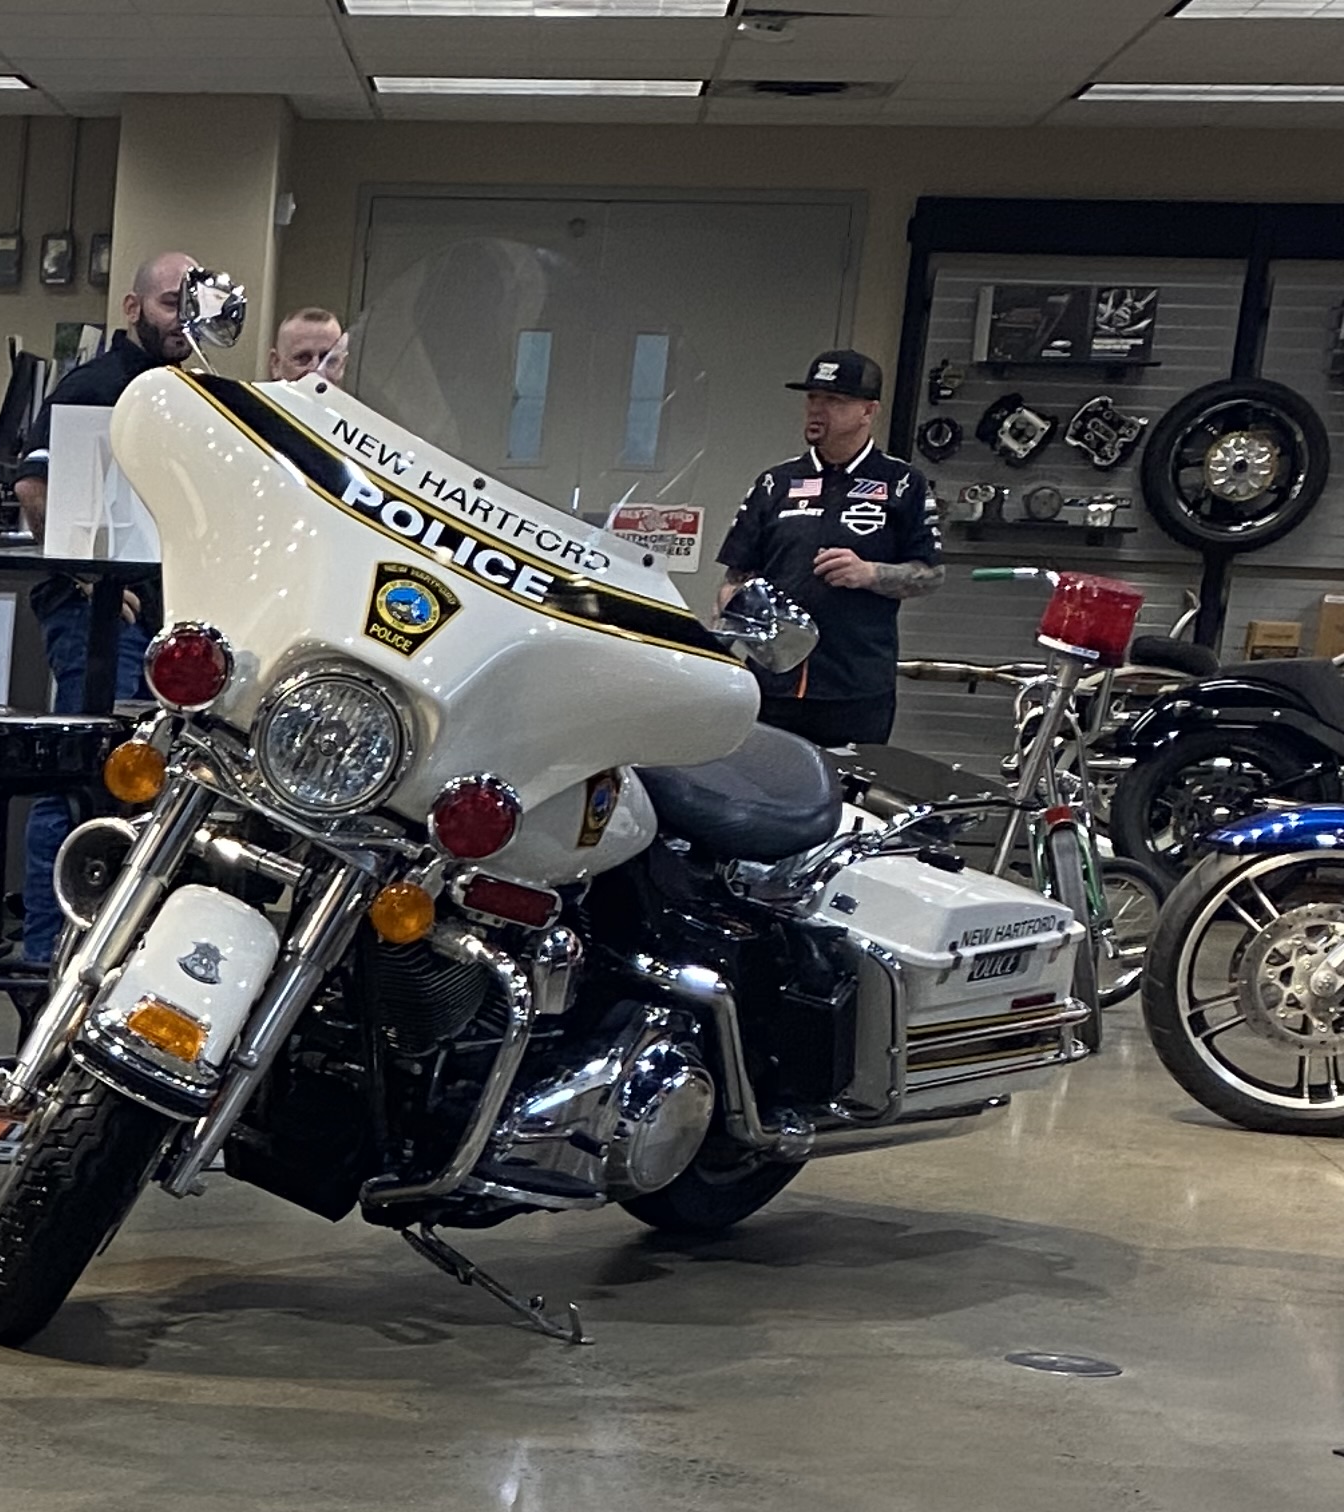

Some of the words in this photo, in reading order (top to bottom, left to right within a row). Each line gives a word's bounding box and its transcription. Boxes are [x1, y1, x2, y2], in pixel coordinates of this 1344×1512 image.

[332, 418, 414, 475] NEW
[418, 470, 611, 575] HARTFORD
[341, 476, 555, 604] POLICE
[369, 623, 413, 652] POLICE
[961, 928, 993, 947] NEW
[994, 915, 1056, 941] HARTFORD
